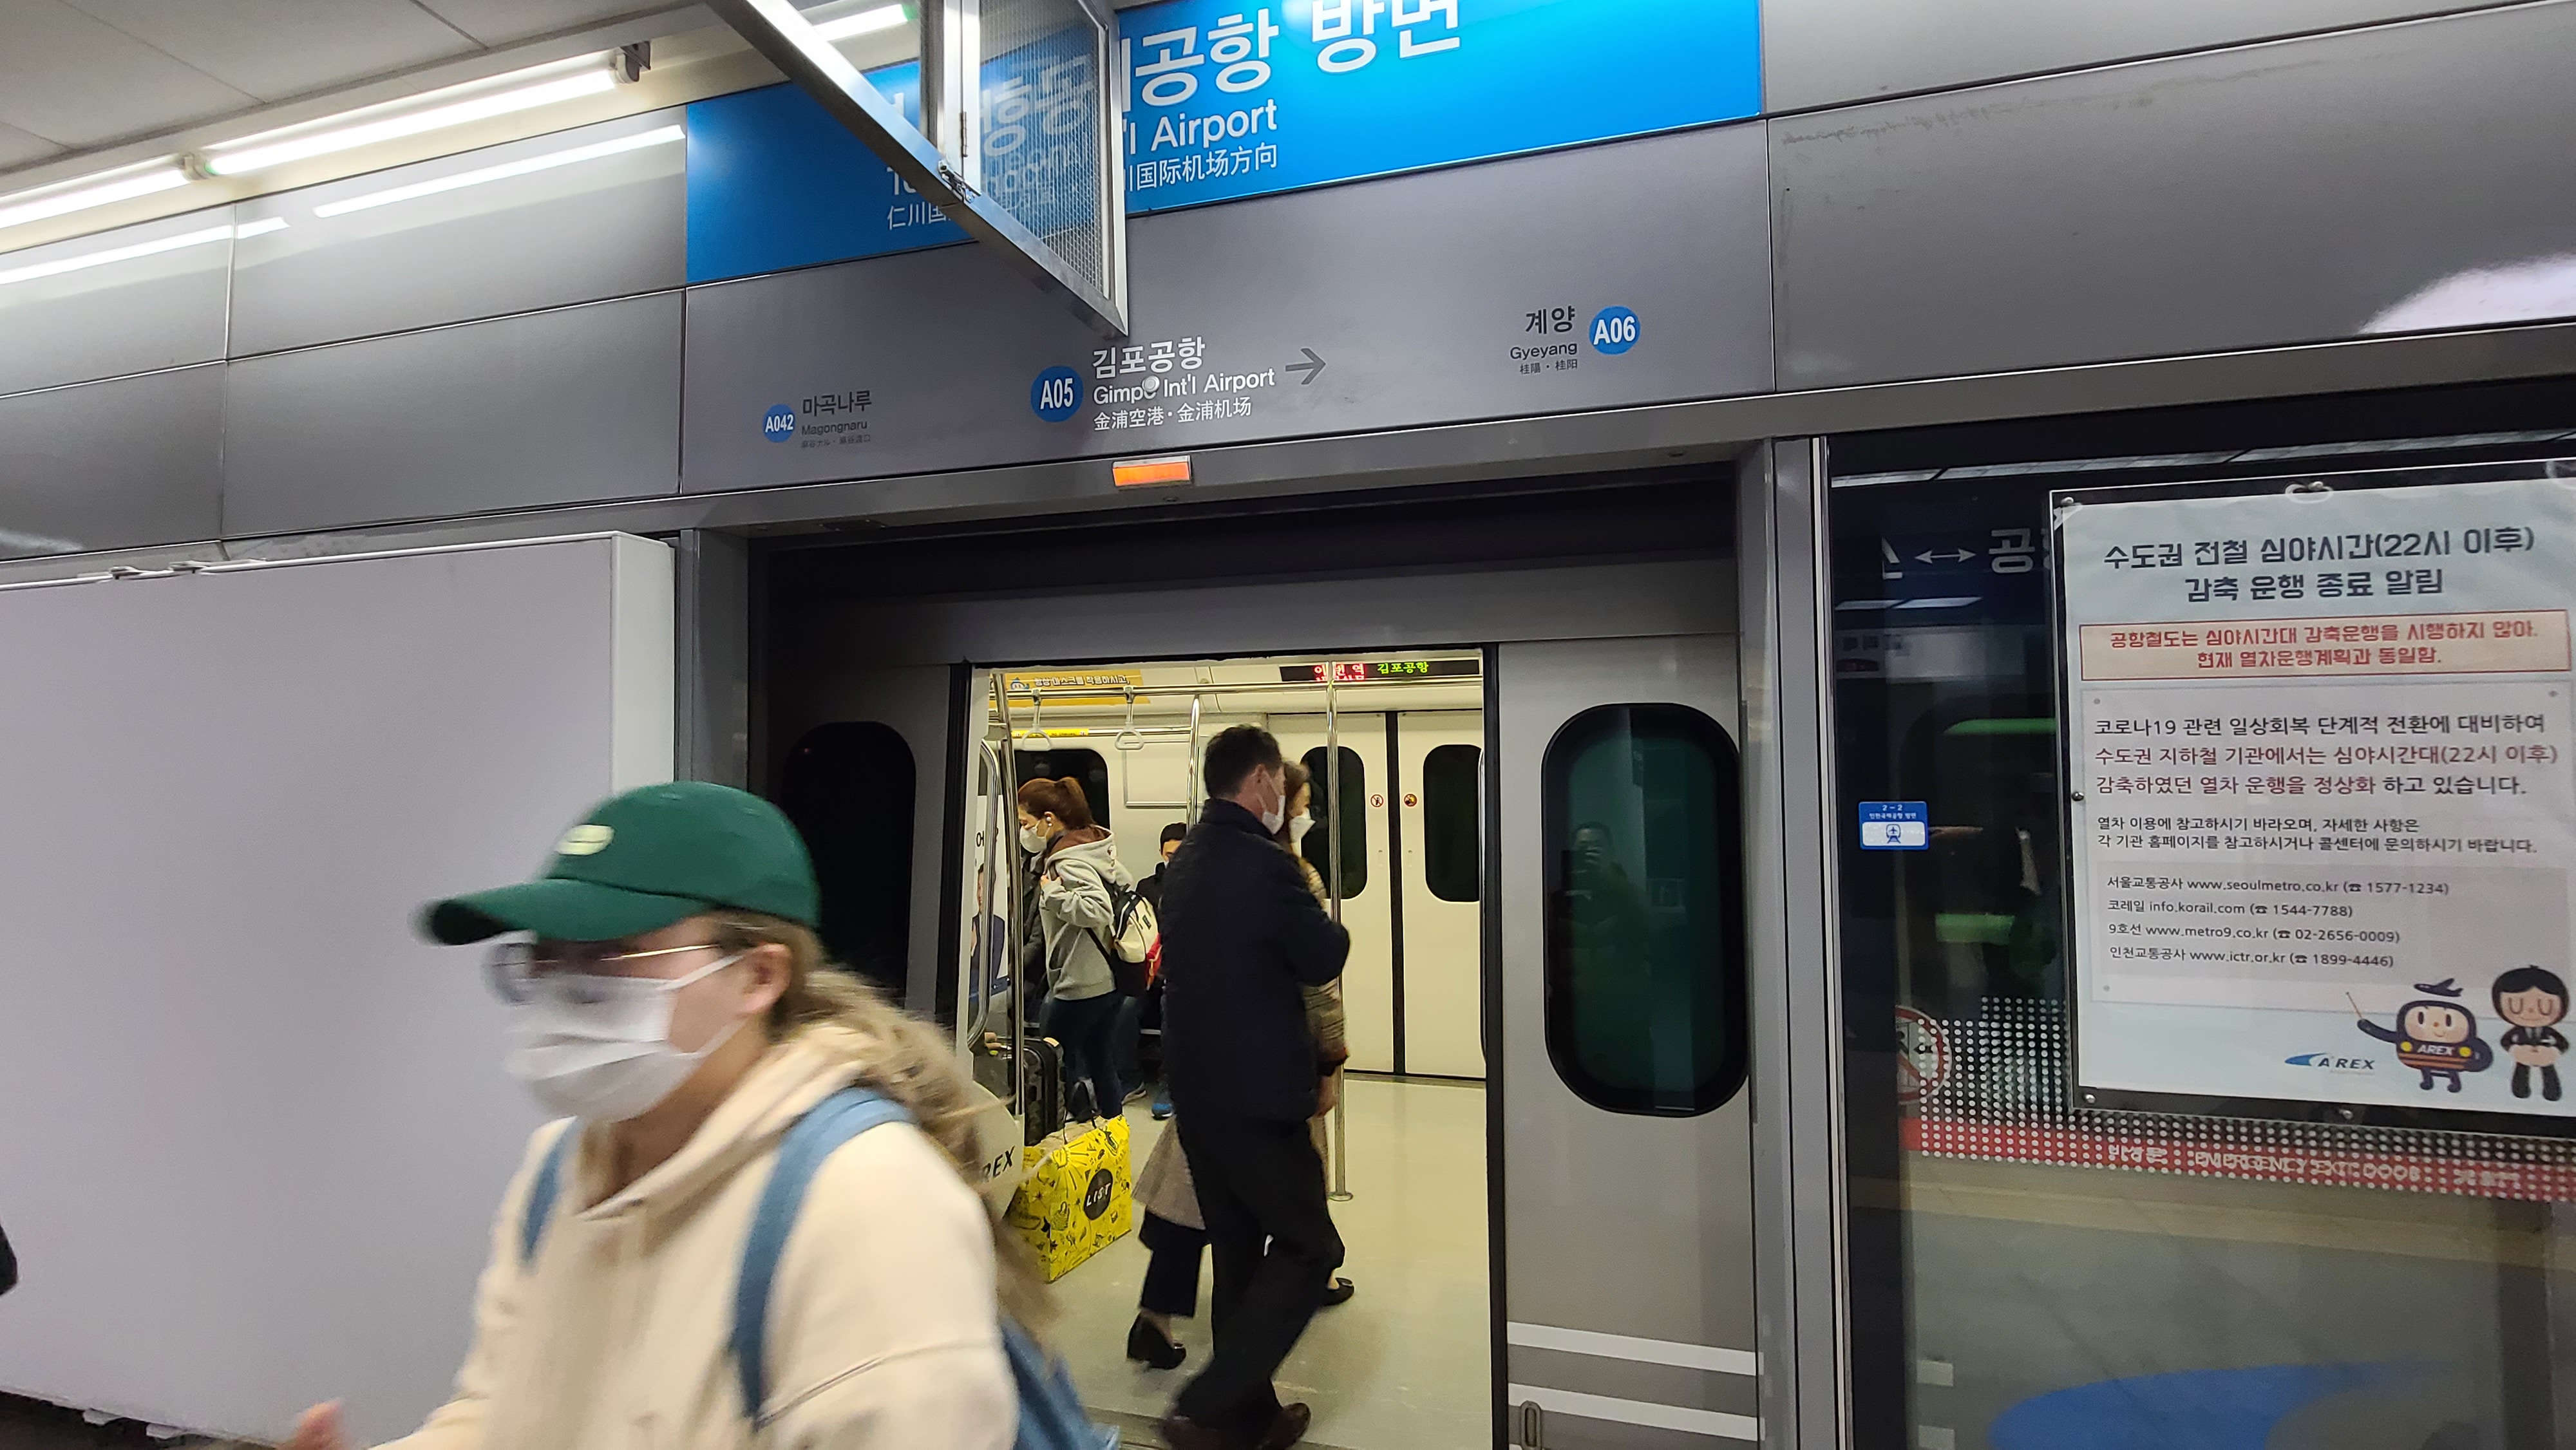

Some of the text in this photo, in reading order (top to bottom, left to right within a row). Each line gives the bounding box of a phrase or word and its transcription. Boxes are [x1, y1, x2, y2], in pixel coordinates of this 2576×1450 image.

[1121, 8, 1280, 112] 공항
[1151, 99, 1278, 151] Airport
[1525, 305, 1576, 334] 계양
[1593, 315, 1636, 345] A06
[1092, 336, 1206, 379] 김포공항
[1510, 343, 1578, 361] Gyeyang
[1039, 377, 1074, 410] A05
[1163, 373, 1197, 398] Int'l
[1203, 368, 1275, 393] Airport
[802, 390, 872, 417] 마곡나루
[764, 414, 794, 433] A042
[801, 420, 868, 437] Magongnaru
[2103, 526, 2535, 569] 수도권 전철 심야시간(22시 이후)
[2184, 568, 2443, 603] 감축 운행 종료 알림
[2110, 630, 2199, 649] 공항철도는
[2206, 626, 2298, 646] 심야시간대
[2304, 624, 2399, 644] 감축운행을
[2407, 621, 2485, 641] 시행하지
[1377, 661, 1430, 675] 김포공항
[2197, 646, 2443, 670] 현재 열차운행계획과 동일함.
[2094, 713, 2545, 737] 코로나19 관련 일상회복 단계적 전환에 대비하여
[2094, 744, 2559, 766] 수도권 지하철 기관에서는 심야시간대(22시 이후)
[2096, 775, 2528, 795] 감축하였던 열차 운행을 정상화 하고 있습니다.
[2097, 816, 2421, 834] 열차 이용에 참고하시기 바라오며, 자세한 사항은
[2097, 834, 2538, 854] 각 기관 홈페이지를 참고하시거나 콜센터에 문의하시기 바랍니다.
[2107, 876, 2184, 890] 서울교통공사
[2186, 878, 2340, 893] www.seoulmetro.co.kr
[2107, 899, 2145, 913] 코레일
[2149, 901, 2246, 914] info.korail.com
[2108, 923, 2142, 936] 9호선
[2145, 927, 2269, 939] www.metro9.co.kr
[2109, 946, 2186, 961] 인천교통공사
[2189, 950, 2286, 964] www.ictr.or.kr
[2417, 1043, 2454, 1057] AREX
[1085, 1182, 1112, 1207] LIST
